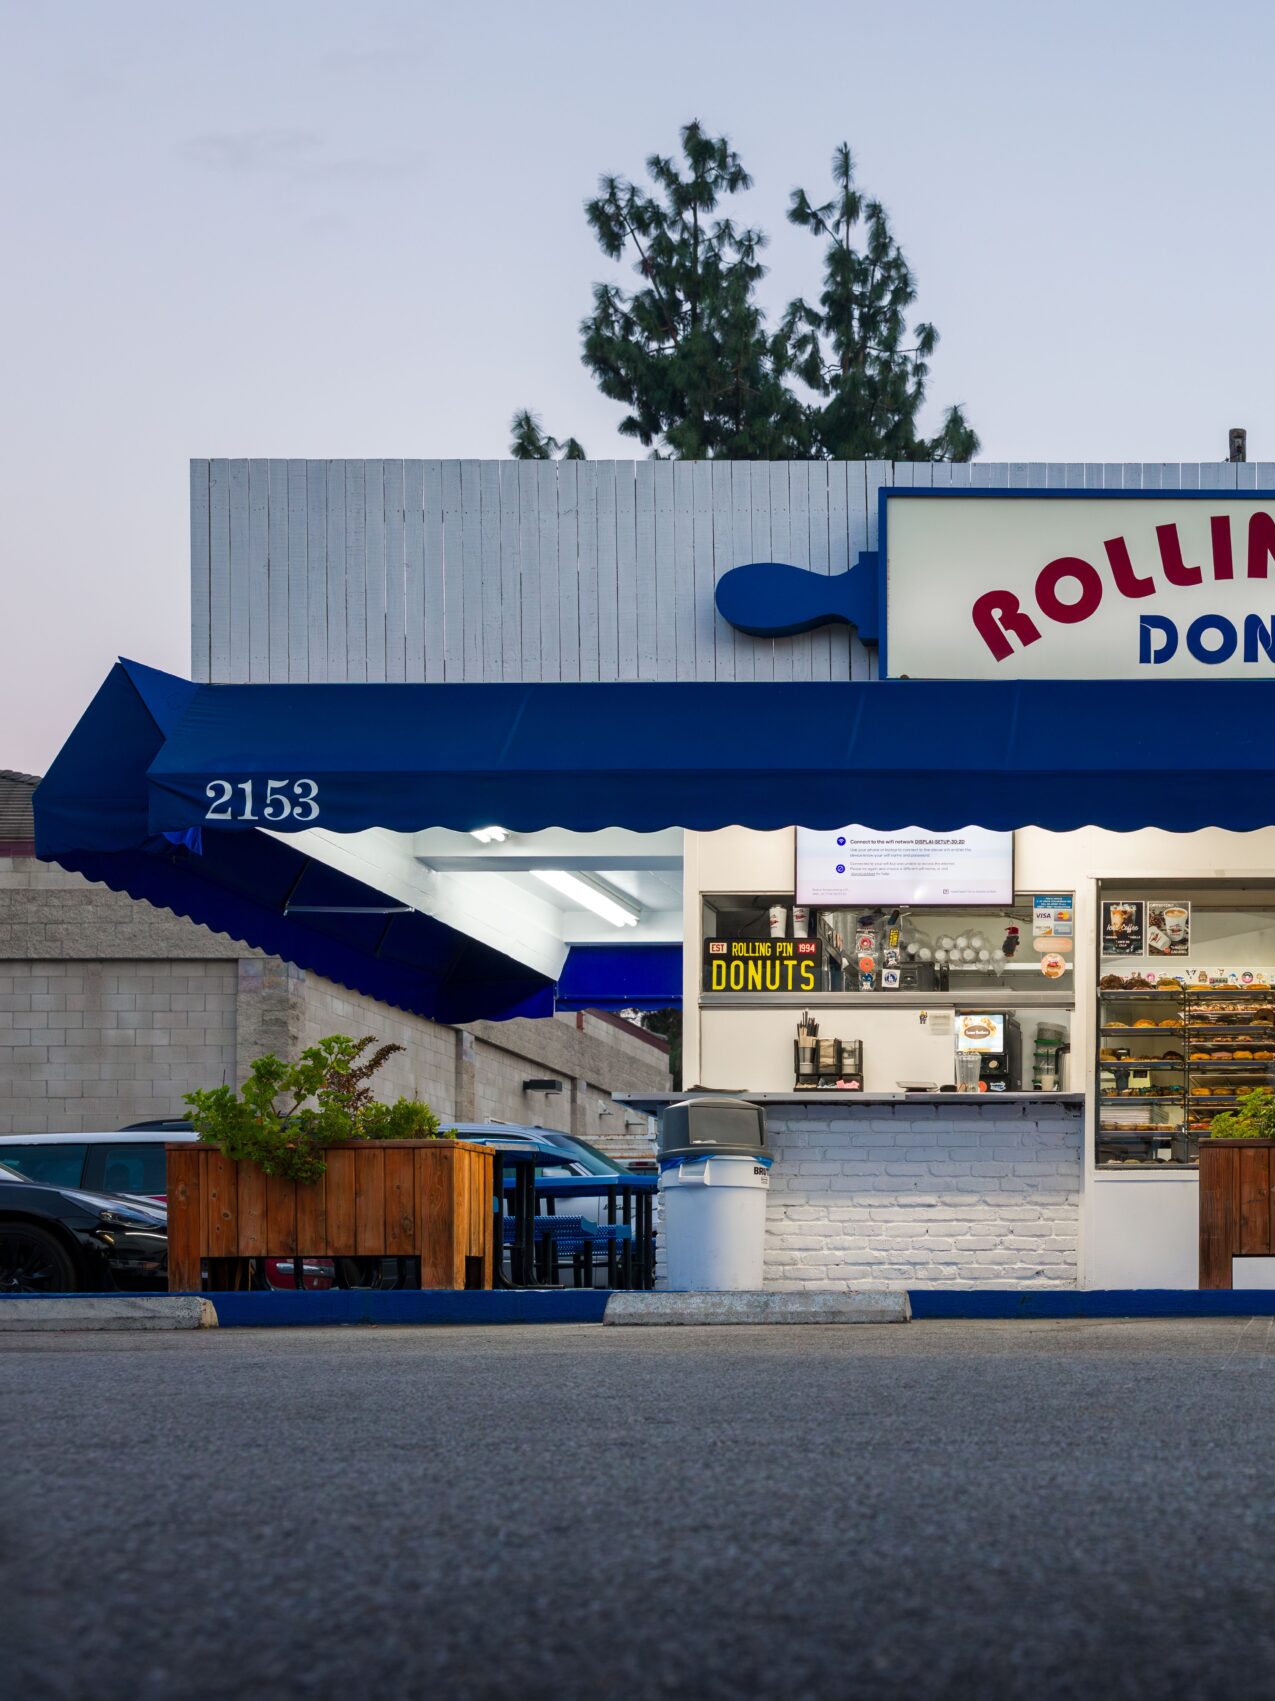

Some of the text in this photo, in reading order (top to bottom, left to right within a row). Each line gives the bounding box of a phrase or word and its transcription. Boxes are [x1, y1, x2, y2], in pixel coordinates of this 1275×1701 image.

[205, 779, 320, 820] 2153
[711, 942, 815, 956] EST ROLLING PIN 1994
[712, 960, 815, 990] DONUTS
